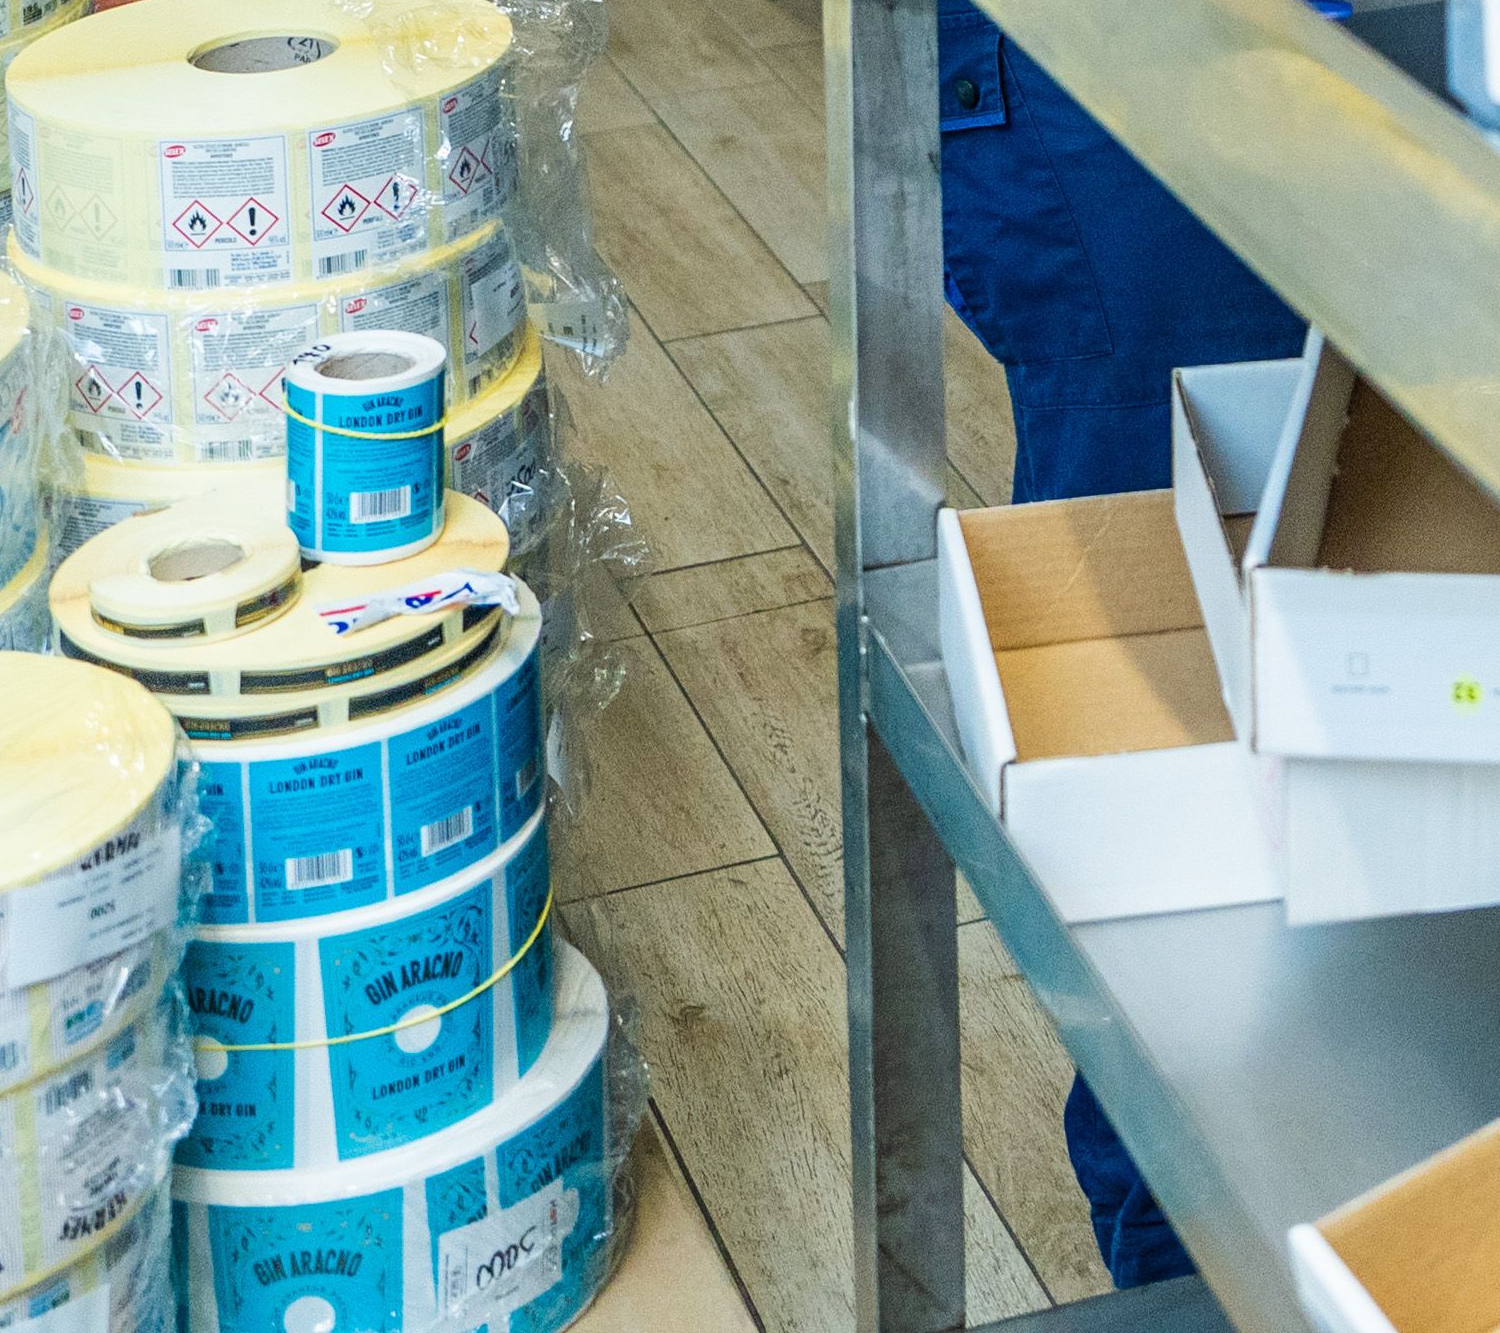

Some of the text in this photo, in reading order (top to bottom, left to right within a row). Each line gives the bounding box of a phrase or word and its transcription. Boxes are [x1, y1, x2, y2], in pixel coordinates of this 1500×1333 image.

[339, 405, 423, 429] LONDON DRY GIN
[406, 723, 482, 767] LONDON DRY GIN
[268, 768, 365, 795] LONDON DRY GIN
[365, 950, 465, 1007] GIN ARACNO
[372, 1052, 467, 1102] LONDON DRY GIN
[210, 1101, 257, 1119] DRY GIN
[252, 1248, 364, 1287] GIN ARACNO
